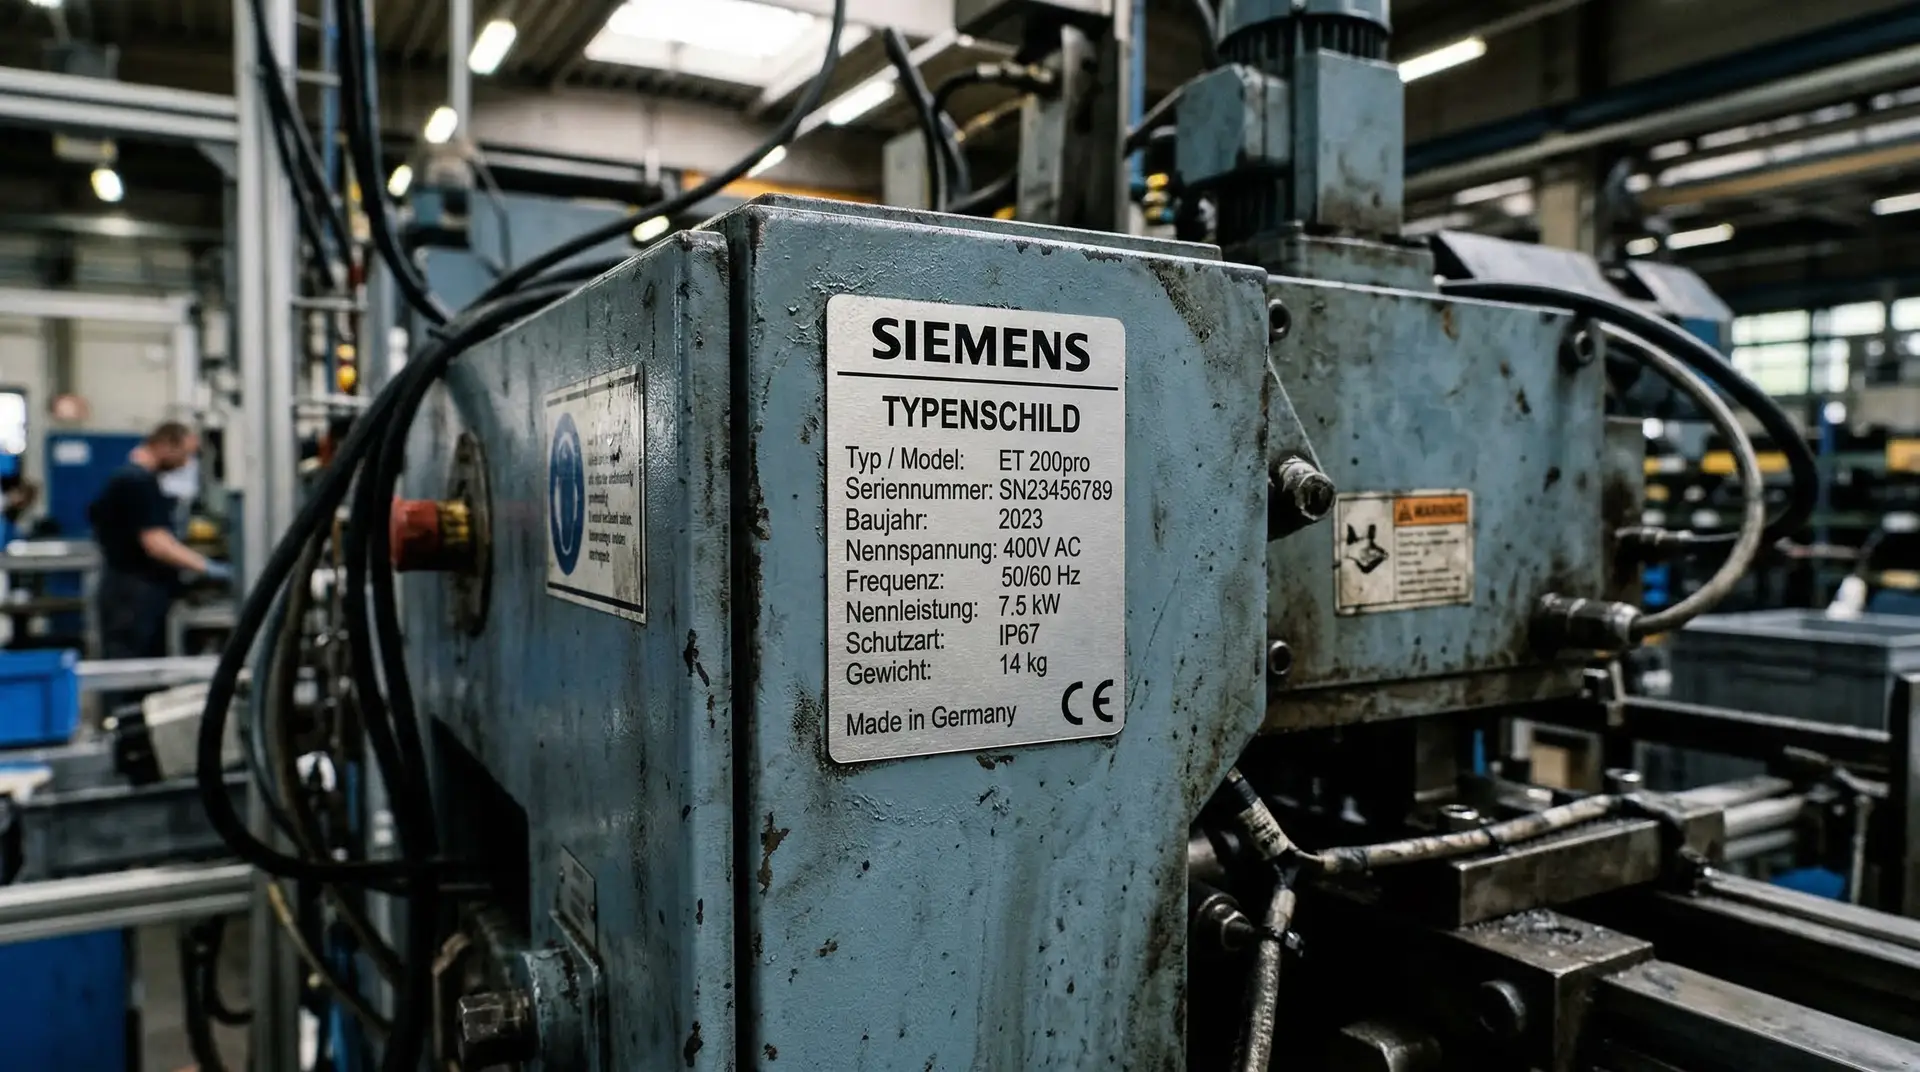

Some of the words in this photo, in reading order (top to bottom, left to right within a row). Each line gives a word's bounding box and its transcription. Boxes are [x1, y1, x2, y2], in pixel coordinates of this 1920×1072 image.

[872, 317, 1091, 372] SIEMENS
[882, 395, 1081, 433] TYPENSCHILD
[845, 446, 881, 474] Typ
[888, 447, 894, 470] /
[901, 447, 964, 470] Model:
[1000, 449, 1024, 471] ET
[1029, 451, 1090, 477] 200pro
[846, 477, 993, 500] Seriennummer:
[1000, 479, 1112, 500] SN23456789
[846, 508, 928, 536] Baujahr:
[999, 508, 1043, 529] 2023
[846, 539, 997, 566] Nennspannung:
[1003, 537, 1050, 558] 400V
[1055, 536, 1081, 557] AC
[846, 570, 944, 596] Frequenz:
[1001, 565, 1051, 587] 50/60
[1057, 565, 1081, 585] Hz
[846, 599, 978, 623] Nennleistung:
[999, 595, 1027, 616] 7.5
[1032, 593, 1061, 615] kW
[846, 629, 945, 654] Schutzart:
[1000, 623, 1040, 646] IP67
[846, 659, 931, 685] Gewicht:
[1000, 653, 1021, 674] 14
[1027, 652, 1047, 677] kg
[1061, 679, 1113, 725] CE
[846, 711, 902, 736] Made
[909, 709, 925, 730] in
[932, 705, 1017, 728] Germany
